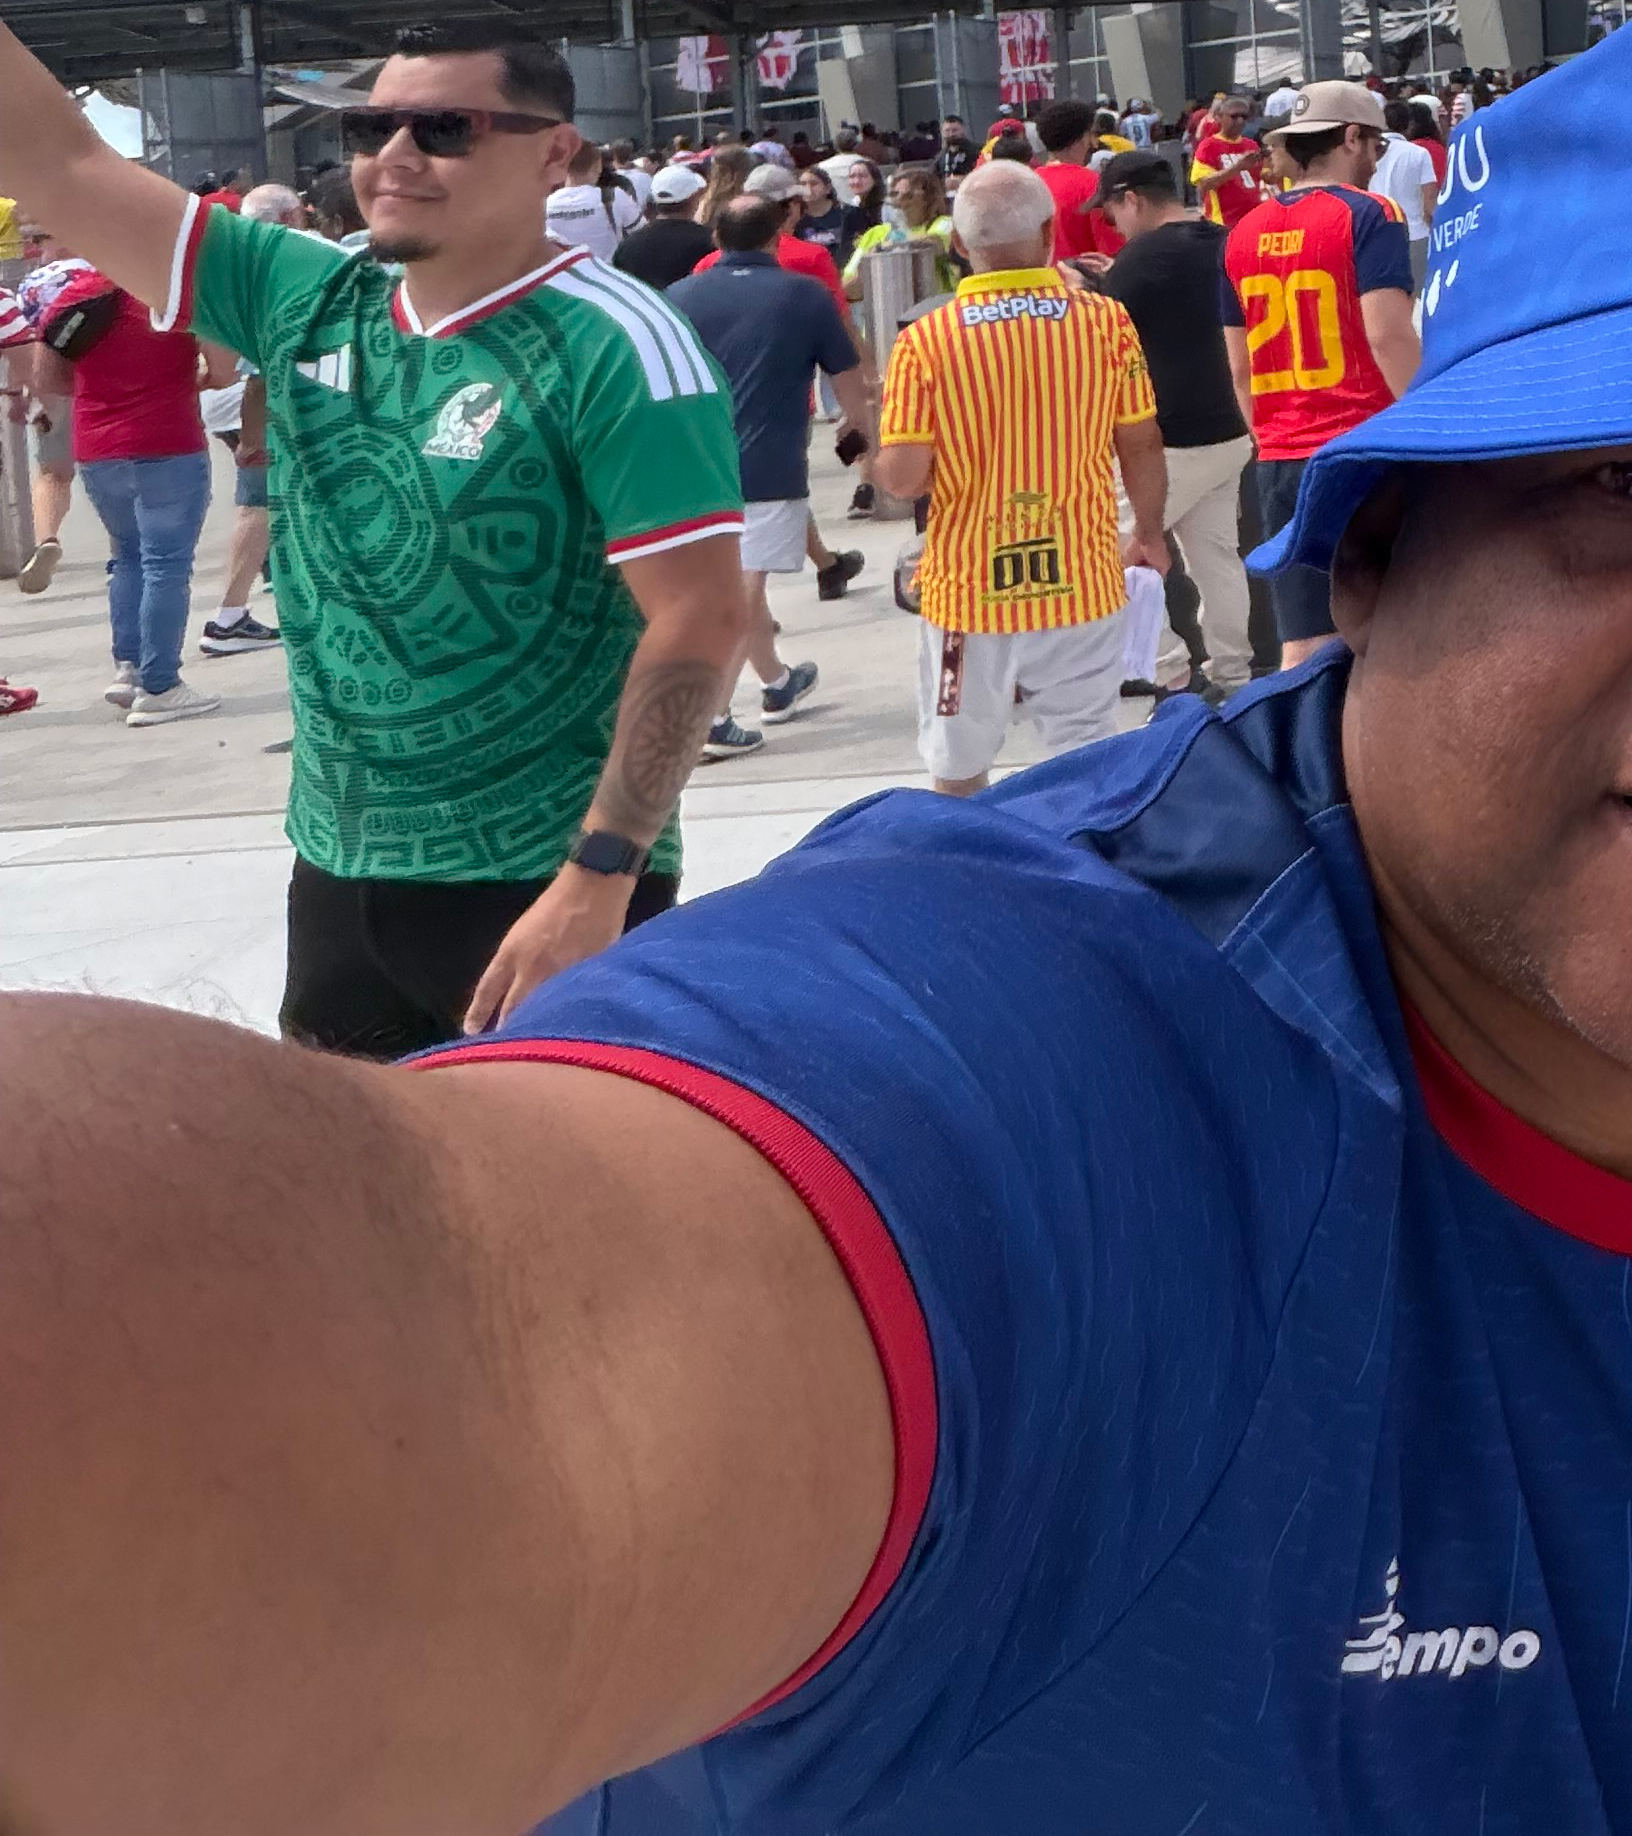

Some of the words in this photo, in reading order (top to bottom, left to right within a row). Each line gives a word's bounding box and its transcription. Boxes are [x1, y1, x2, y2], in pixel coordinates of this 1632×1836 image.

[1433, 203, 1483, 252] VERDE
[962, 293, 1069, 326] BetPlay
[1240, 268, 1345, 396] 20
